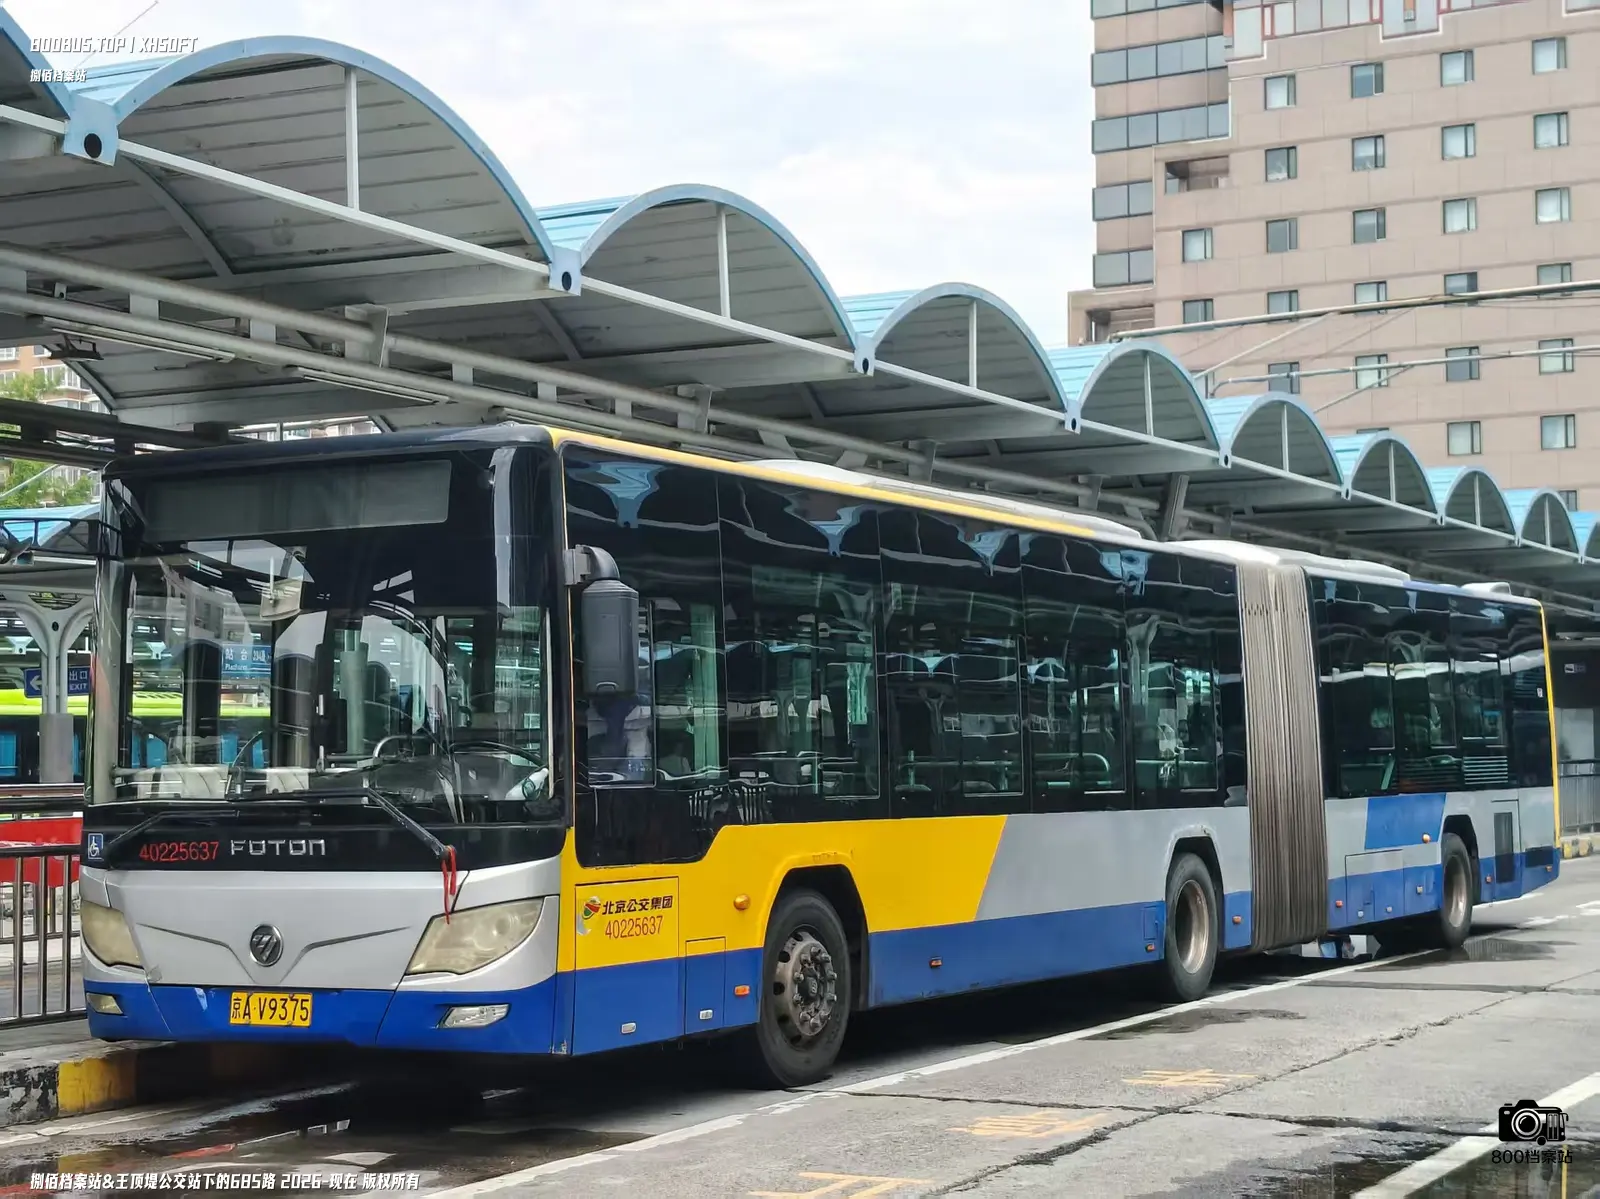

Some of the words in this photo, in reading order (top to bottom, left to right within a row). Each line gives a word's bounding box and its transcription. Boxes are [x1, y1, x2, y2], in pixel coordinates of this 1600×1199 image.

[69, 670, 88, 681] 出口
[69, 682, 88, 691] EXIT
[139, 841, 220, 862] 40225637
[230, 839, 326, 856] FOTON
[602, 895, 673, 915] 北京公交集团
[605, 915, 663, 940] 40225637
